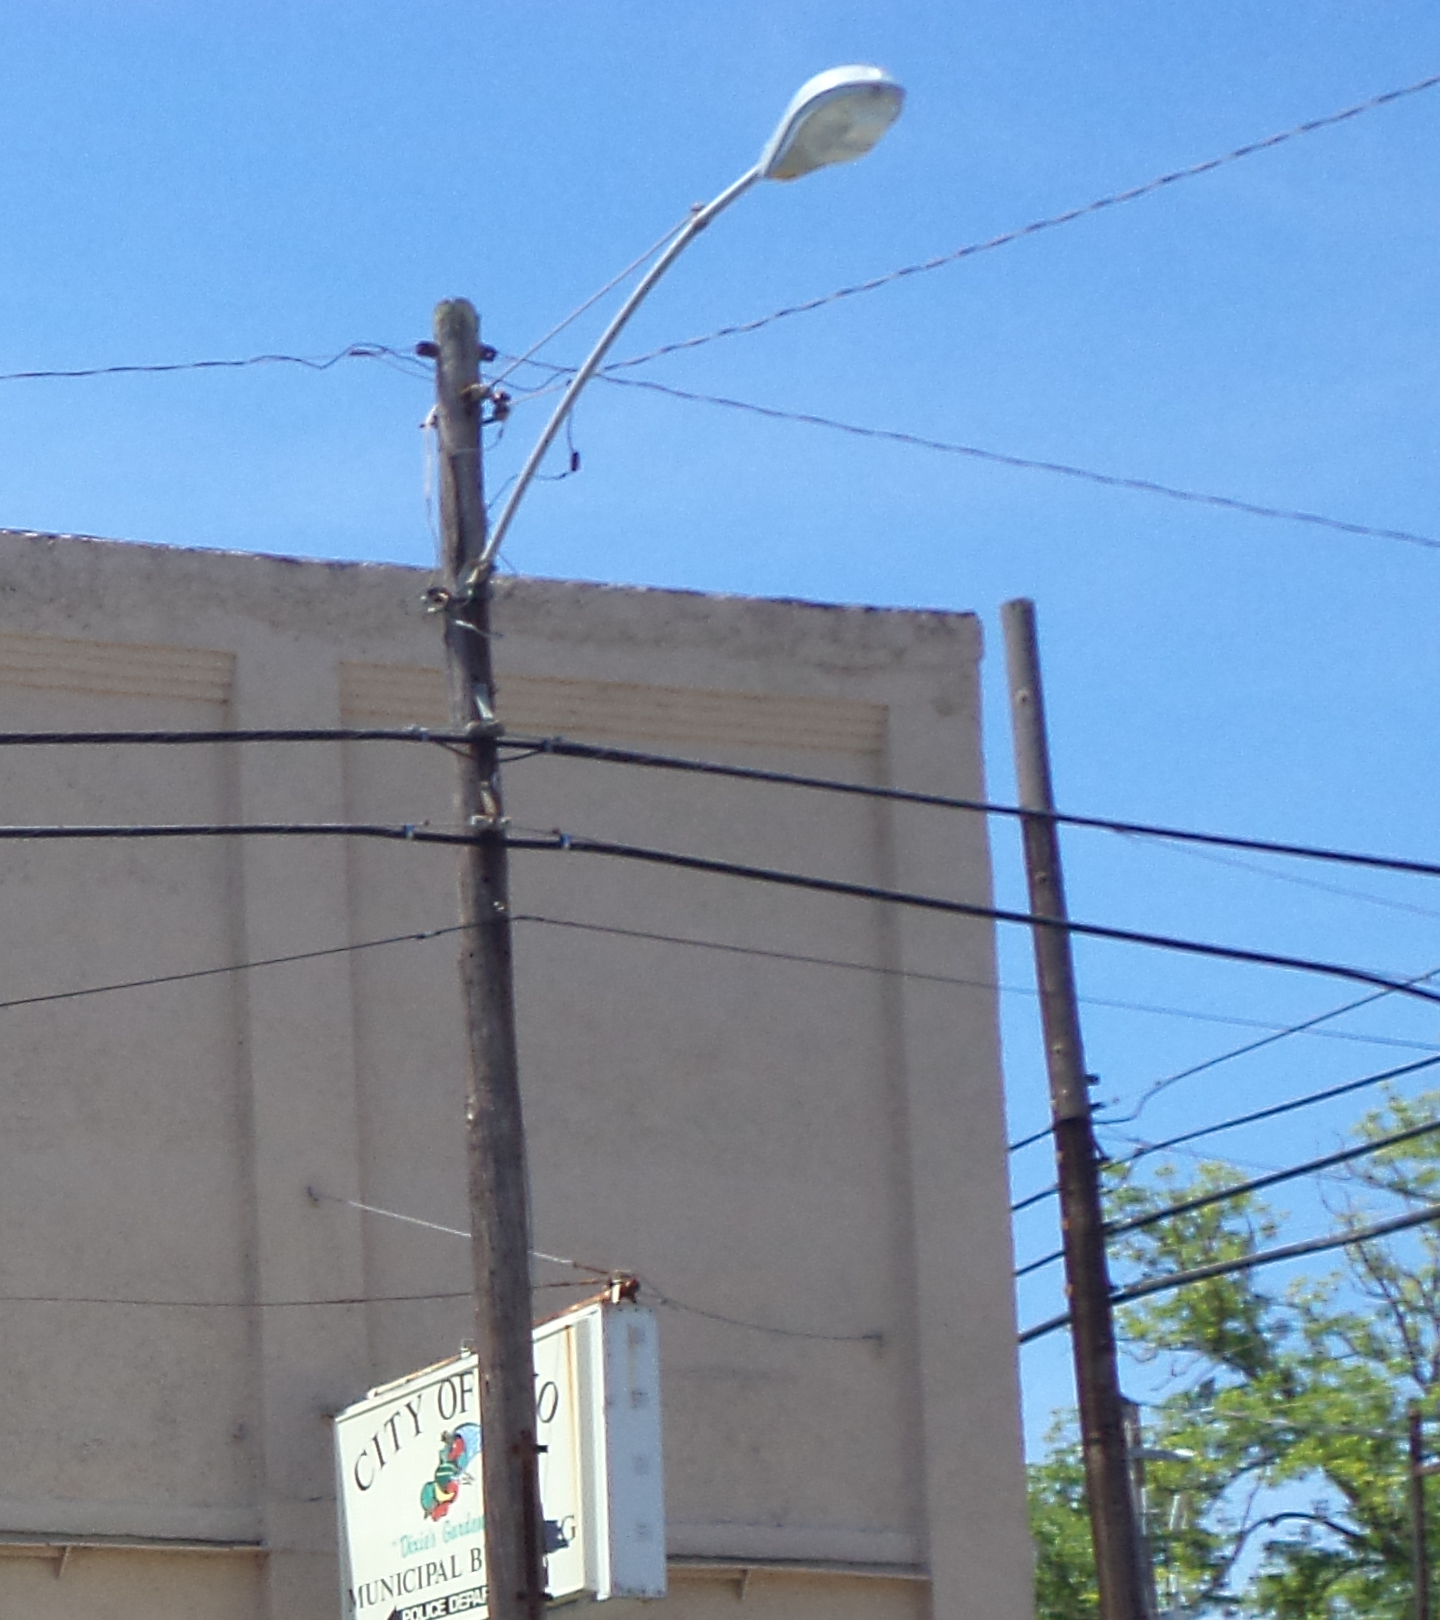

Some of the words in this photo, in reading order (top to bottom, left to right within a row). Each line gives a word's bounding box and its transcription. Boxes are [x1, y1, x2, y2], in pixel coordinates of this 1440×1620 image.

[353, 1394, 424, 1491] CITY
[437, 1370, 474, 1421] OF
[349, 1554, 462, 1612] MUNICIPAL
